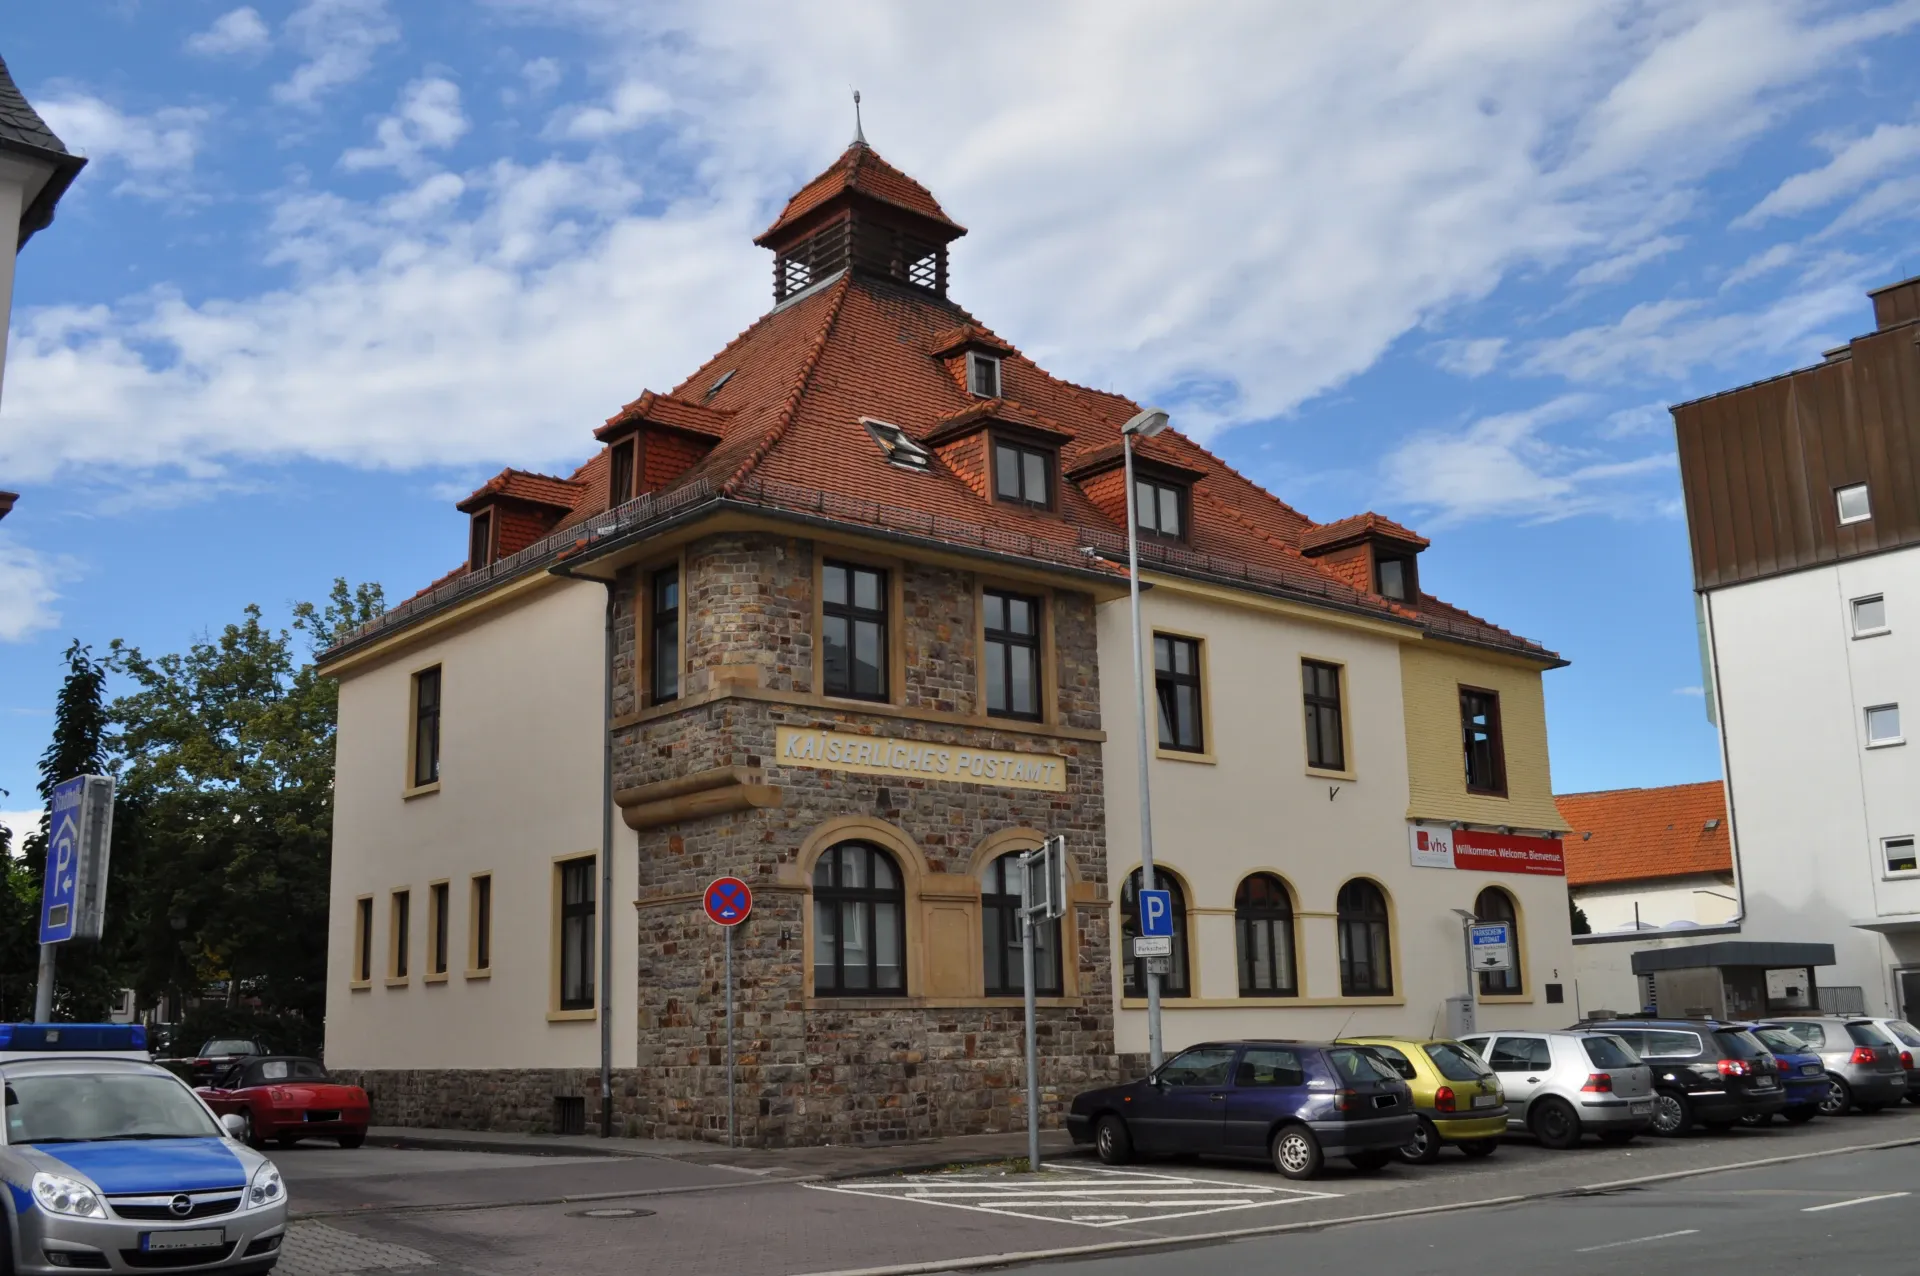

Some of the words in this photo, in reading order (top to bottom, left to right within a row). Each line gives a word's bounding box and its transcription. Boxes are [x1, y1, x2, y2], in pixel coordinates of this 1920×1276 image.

[1430, 837, 1447, 853] vhs
[1455, 844, 1498, 857] Willkommen.
[1499, 847, 1528, 859] Welcome.
[1529, 850, 1562, 862] Bienvenue.
[54, 838, 71, 897] P
[1147, 896, 1164, 930] P
[1479, 936, 1500, 944] AUTOMAT
